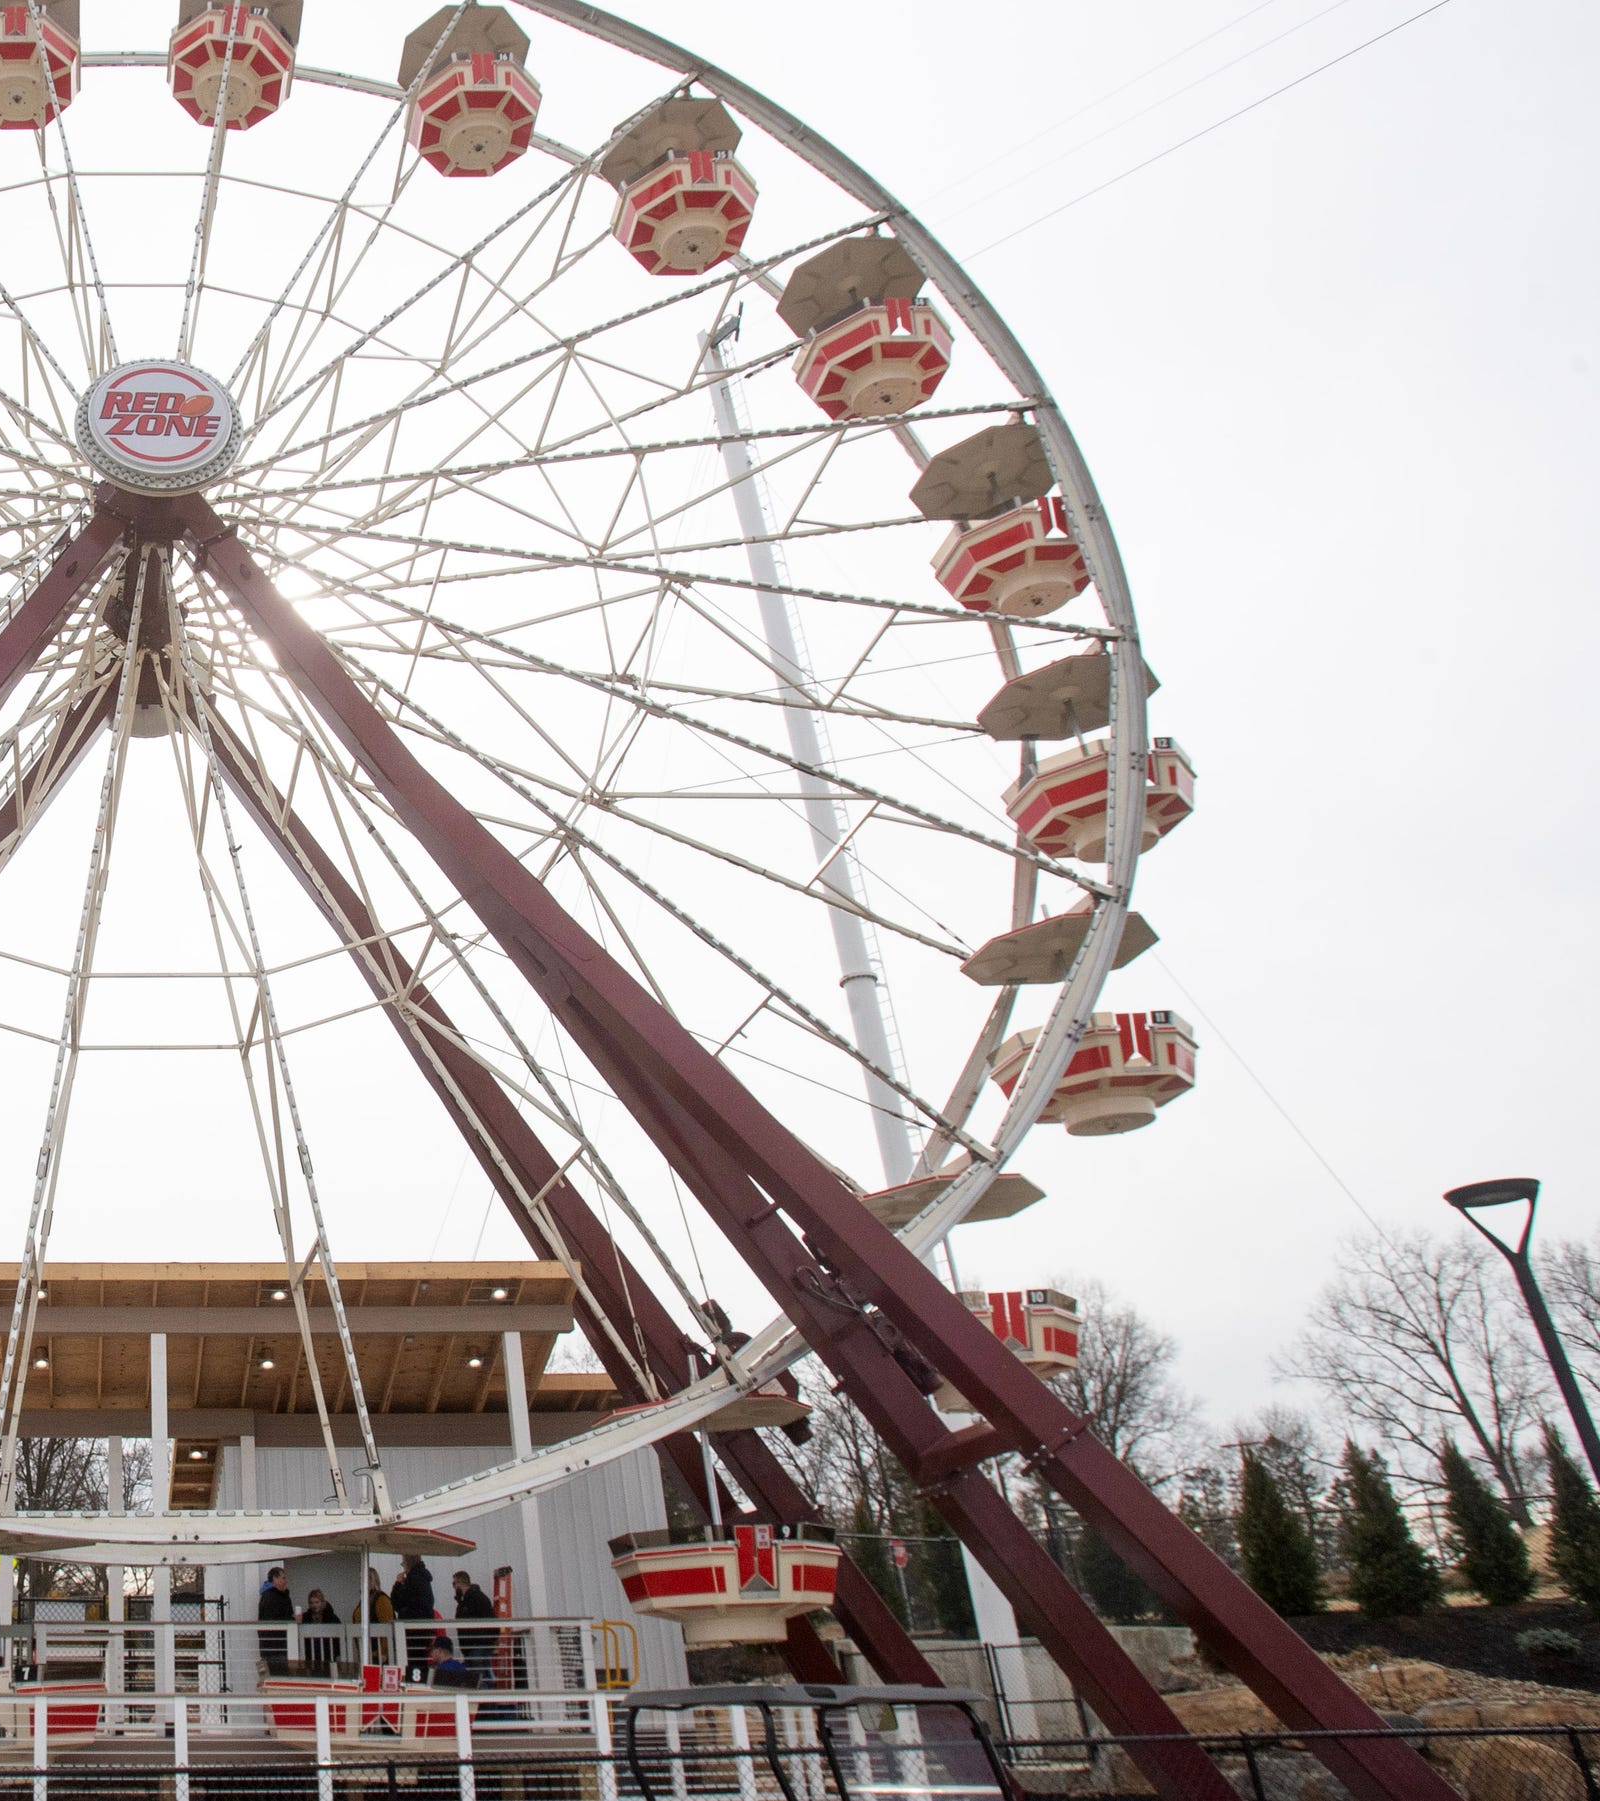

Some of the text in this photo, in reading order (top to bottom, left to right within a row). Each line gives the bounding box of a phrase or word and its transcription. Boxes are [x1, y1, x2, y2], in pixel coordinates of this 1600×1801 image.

[100, 391, 186, 419] RED
[105, 413, 221, 438] ZONE
[1031, 1291, 1045, 1303] 10
[781, 1525, 791, 1538] 9
[21, 1666, 31, 1681] 7
[412, 1668, 422, 1682] 8
